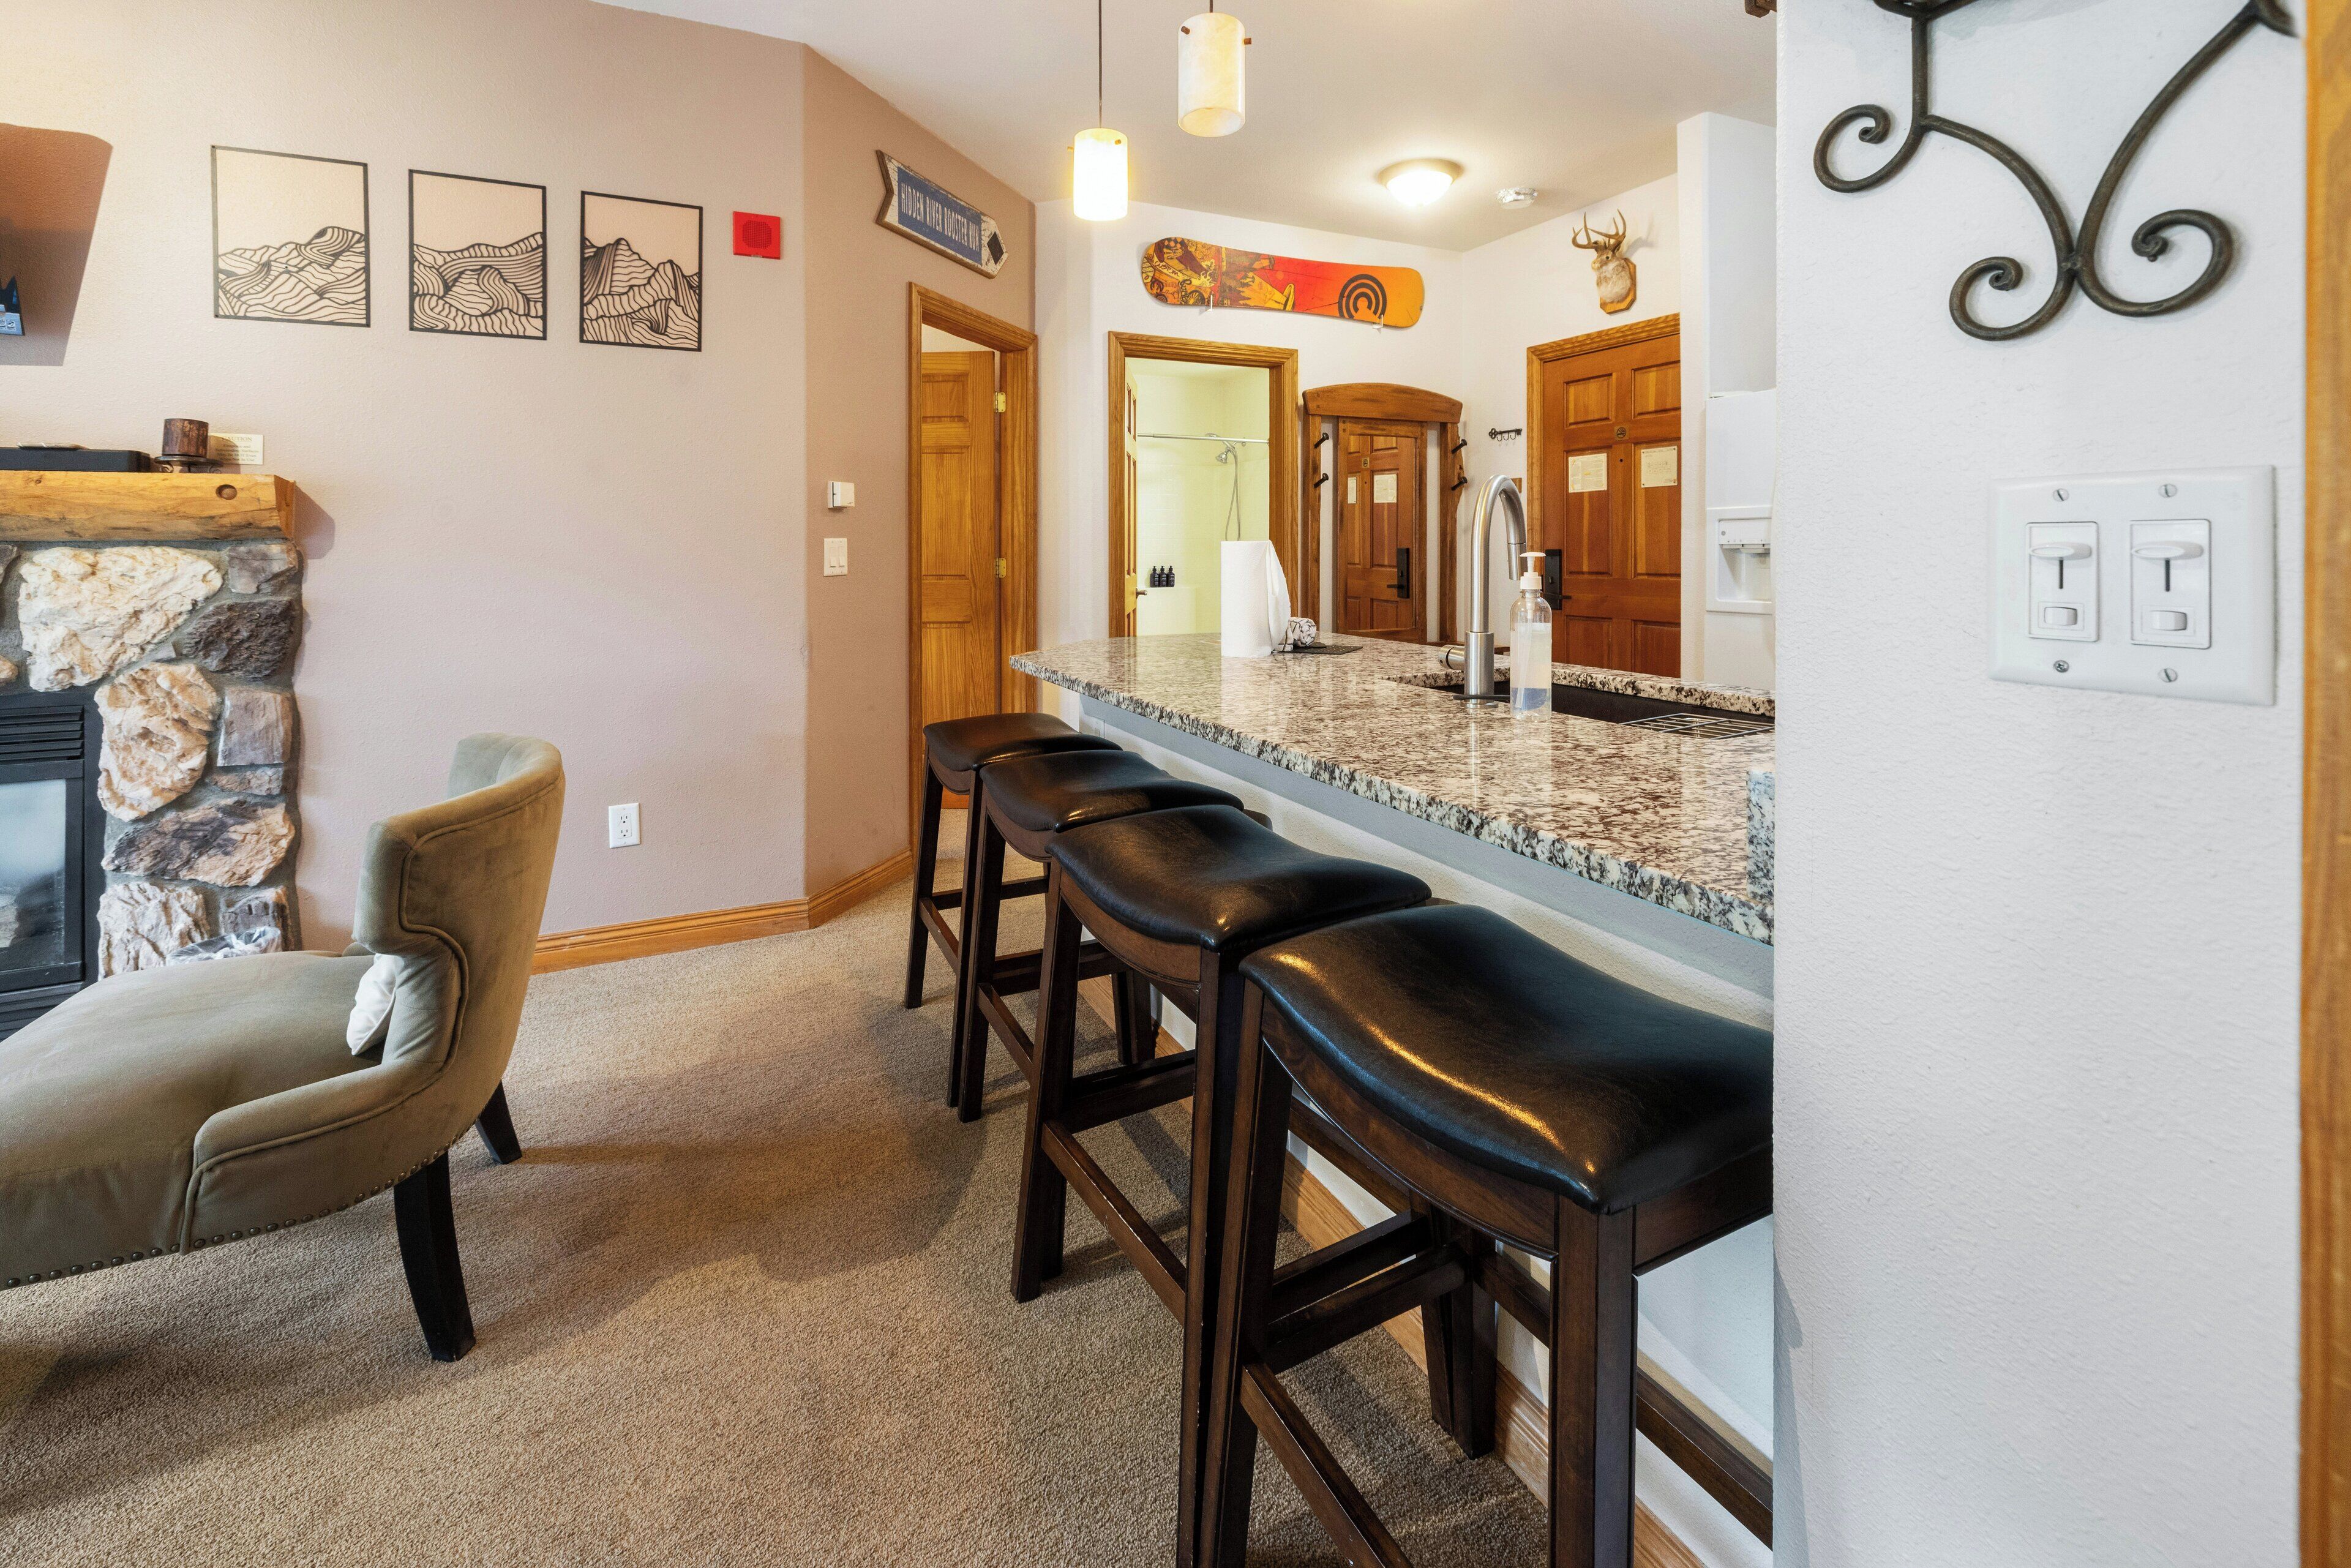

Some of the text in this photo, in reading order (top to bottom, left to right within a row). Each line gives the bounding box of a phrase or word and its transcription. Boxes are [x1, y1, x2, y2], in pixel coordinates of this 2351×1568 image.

[901, 182, 924, 223] HIDDEN
[926, 196, 942, 233] RIVER
[944, 206, 967, 246] ROOSTER
[969, 221, 980, 252] RUN
